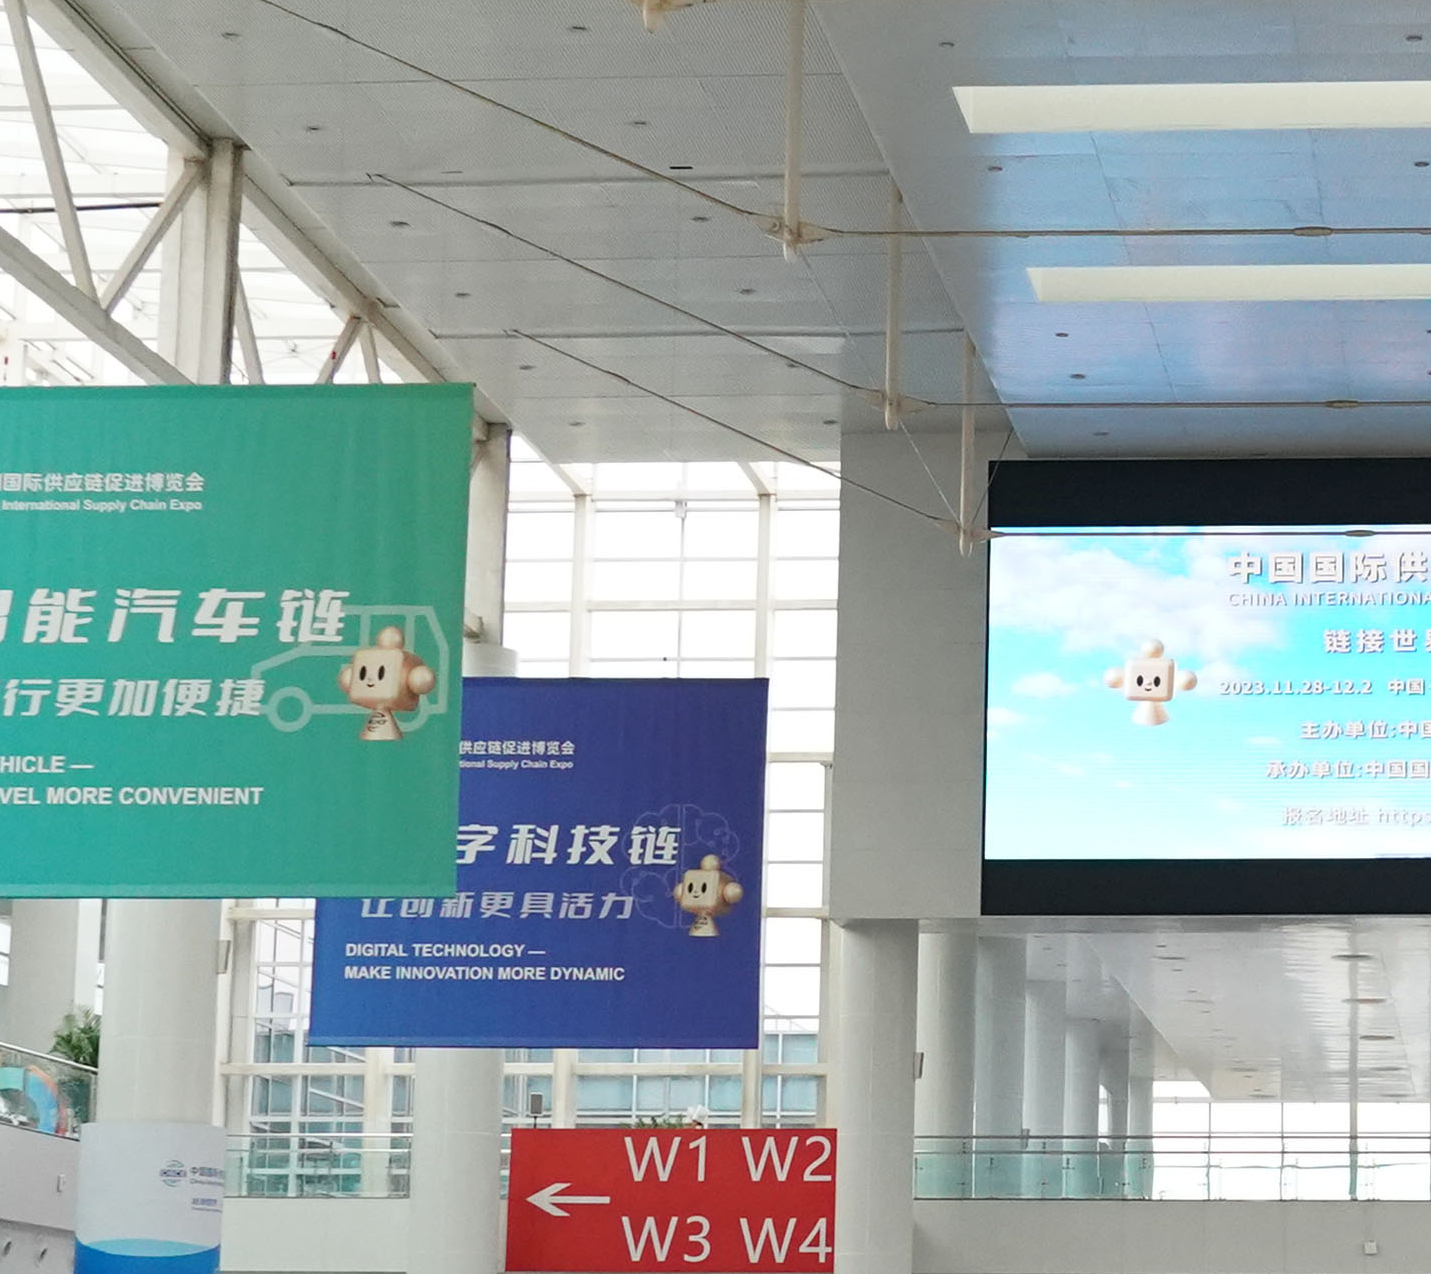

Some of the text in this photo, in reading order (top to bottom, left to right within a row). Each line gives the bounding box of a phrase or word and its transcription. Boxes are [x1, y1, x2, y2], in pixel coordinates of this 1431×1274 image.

[0, 500, 80, 511] International
[82, 499, 127, 512] Supply
[129, 499, 167, 510] Chain
[169, 499, 202, 511] Expo
[1228, 591, 1287, 607] CHINA
[1219, 679, 1373, 696] 2023.11.28-12.2
[487, 760, 518, 770] Supply
[521, 759, 547, 769] Chain
[550, 760, 574, 770] Expo
[46, 787, 112, 804] MORE
[119, 787, 264, 805] CONVENIENT
[1282, 806, 1370, 826] 报名地址
[361, 891, 634, 920] 让创新更具活力
[346, 943, 525, 957] DIGITAL TECHNOLOGY
[345, 966, 624, 980] MAKE INNOVATION MORE DYNAMIC
[625, 1136, 831, 1181] W1 W2
[622, 1216, 832, 1263] W3 W4
